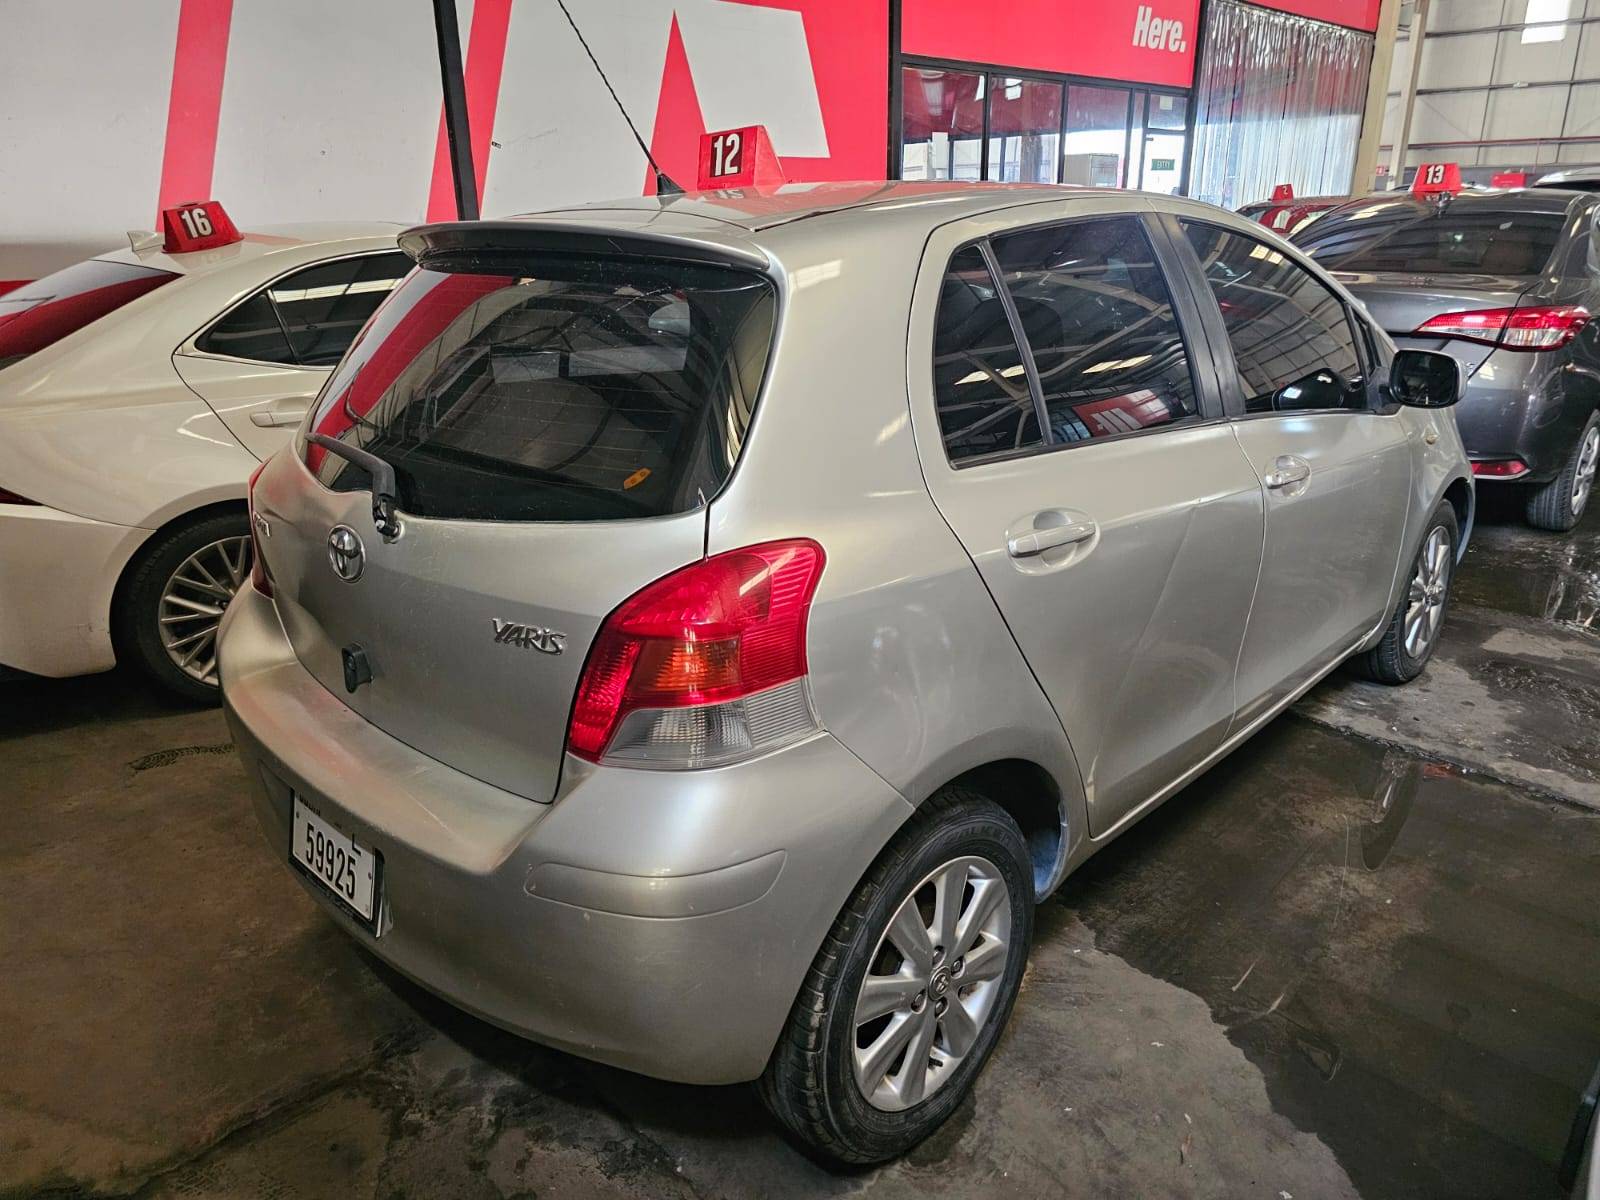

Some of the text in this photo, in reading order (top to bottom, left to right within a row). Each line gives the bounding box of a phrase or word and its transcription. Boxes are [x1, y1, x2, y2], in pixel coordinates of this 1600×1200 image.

[1132, 5, 1187, 53] Here.
[713, 133, 740, 176] 12
[1426, 164, 1445, 184] 13
[181, 208, 213, 239] 16
[306, 822, 356, 900] 59925
